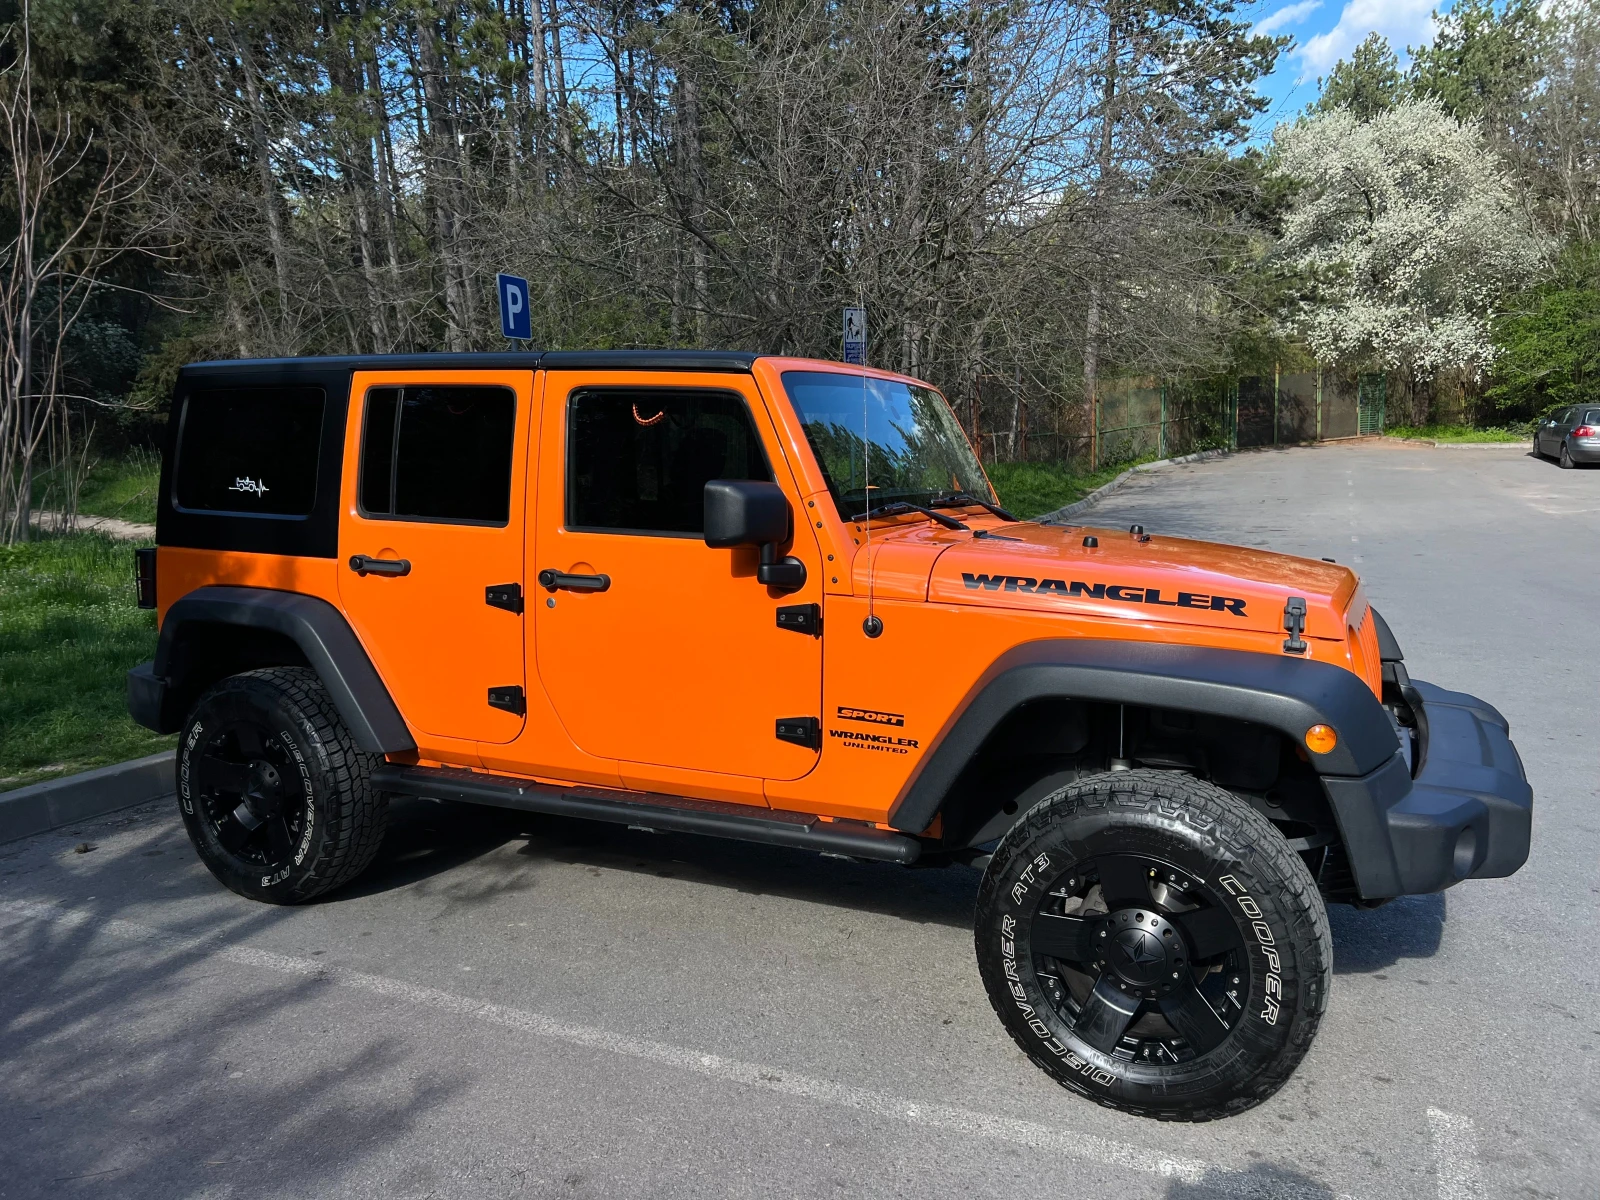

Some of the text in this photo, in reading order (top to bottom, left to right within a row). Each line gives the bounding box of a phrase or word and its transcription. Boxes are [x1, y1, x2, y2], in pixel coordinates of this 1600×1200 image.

[506, 283, 523, 330] P
[961, 572, 1248, 617] WRANGLER
[829, 729, 919, 749] WRANGLER
[839, 708, 904, 725] SPORT
[181, 721, 204, 815] COOPER
[843, 741, 908, 755] UNLIMITED
[261, 730, 316, 887] DISCOVERER AT3
[1000, 852, 1117, 1088] DISCOVERER AT3
[1218, 874, 1282, 1026] COOPER
